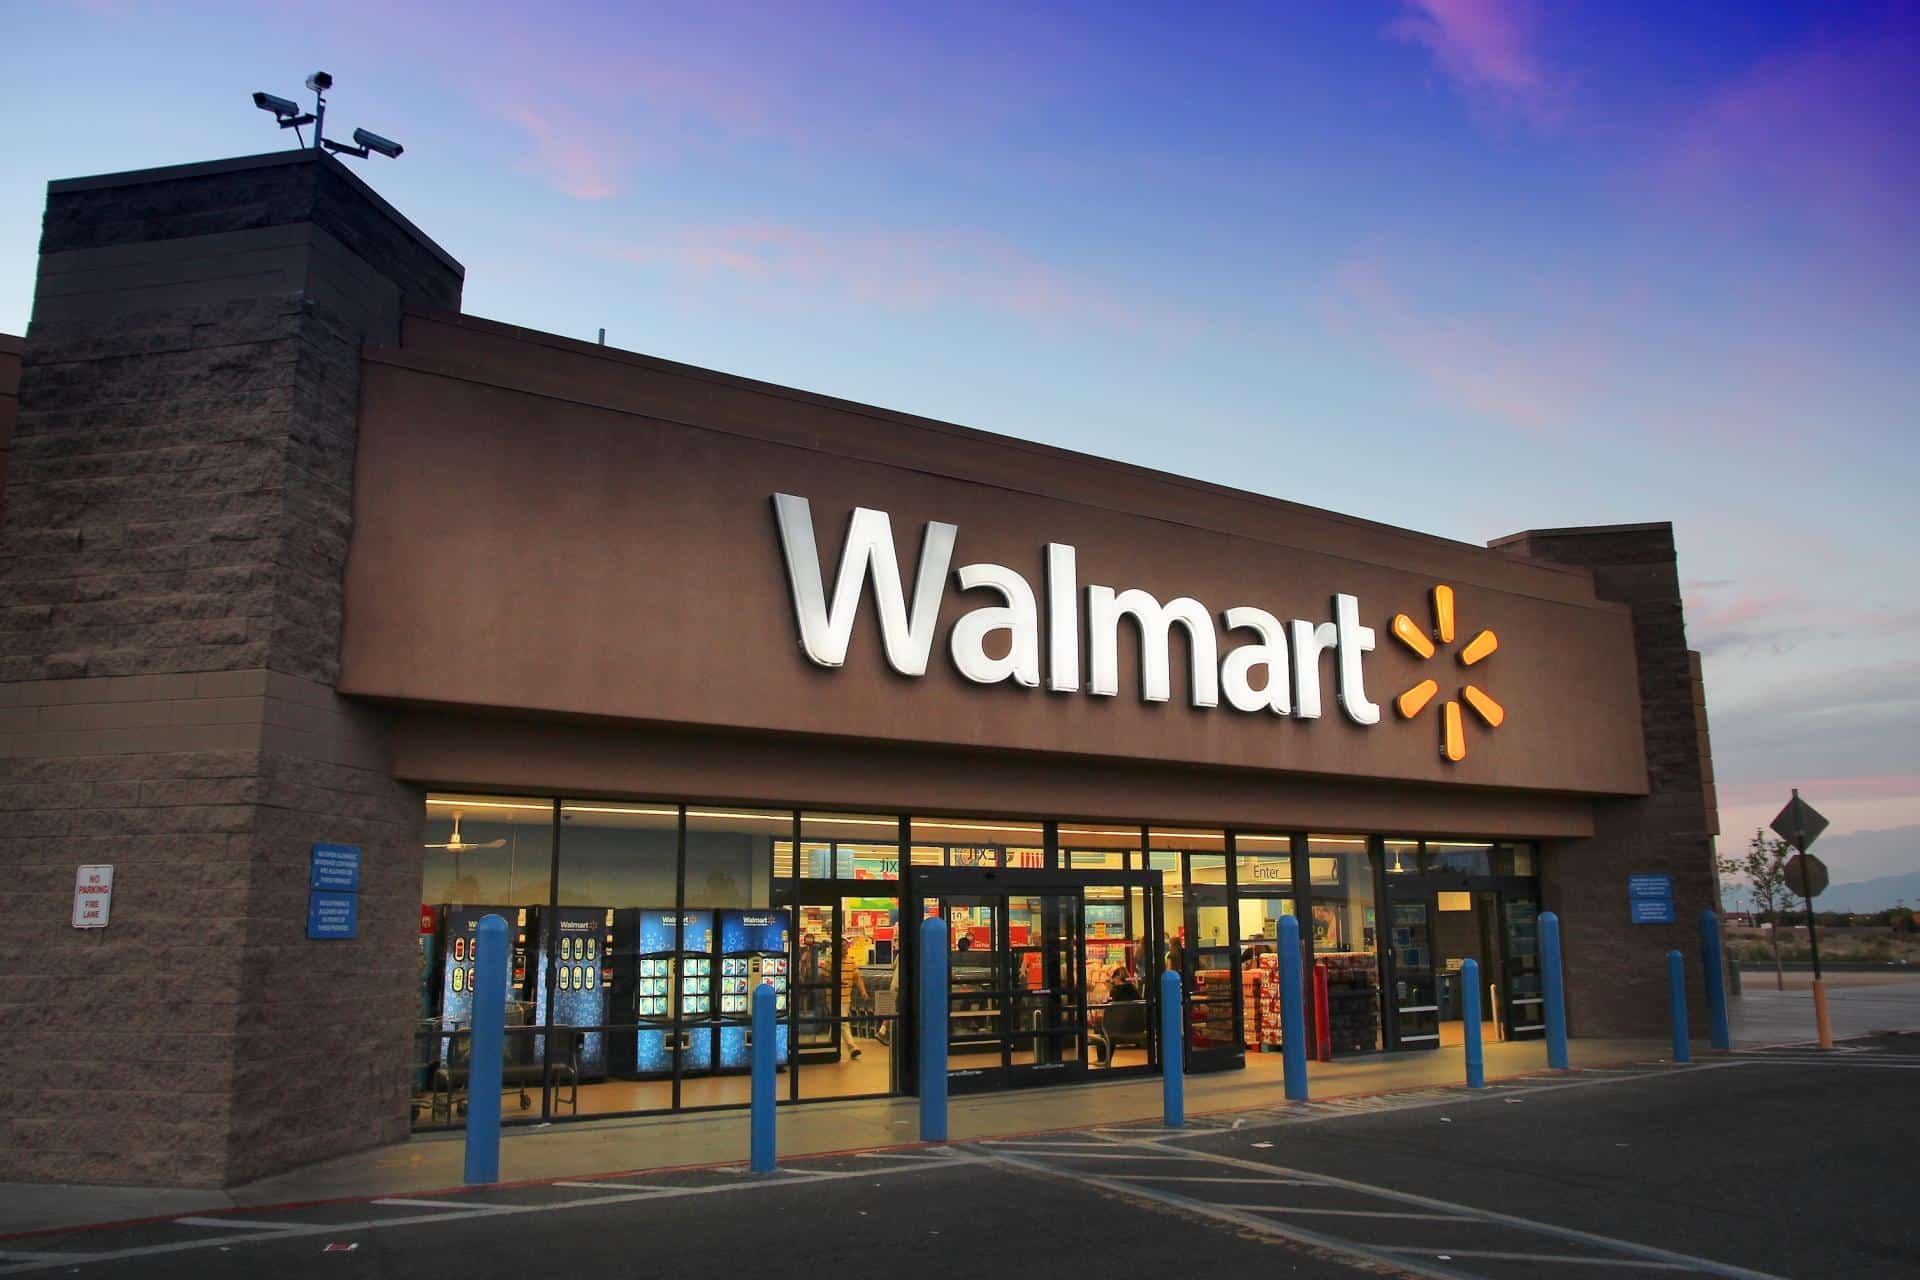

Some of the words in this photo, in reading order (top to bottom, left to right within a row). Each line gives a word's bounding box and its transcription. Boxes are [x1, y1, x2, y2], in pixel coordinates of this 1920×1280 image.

[772, 492, 1380, 725] Walmart
[1253, 865, 1280, 879] Enter
[89, 874, 100, 884] NO
[79, 885, 109, 895] PARKING
[85, 900, 100, 908] FIRE
[83, 910, 100, 919] LANE
